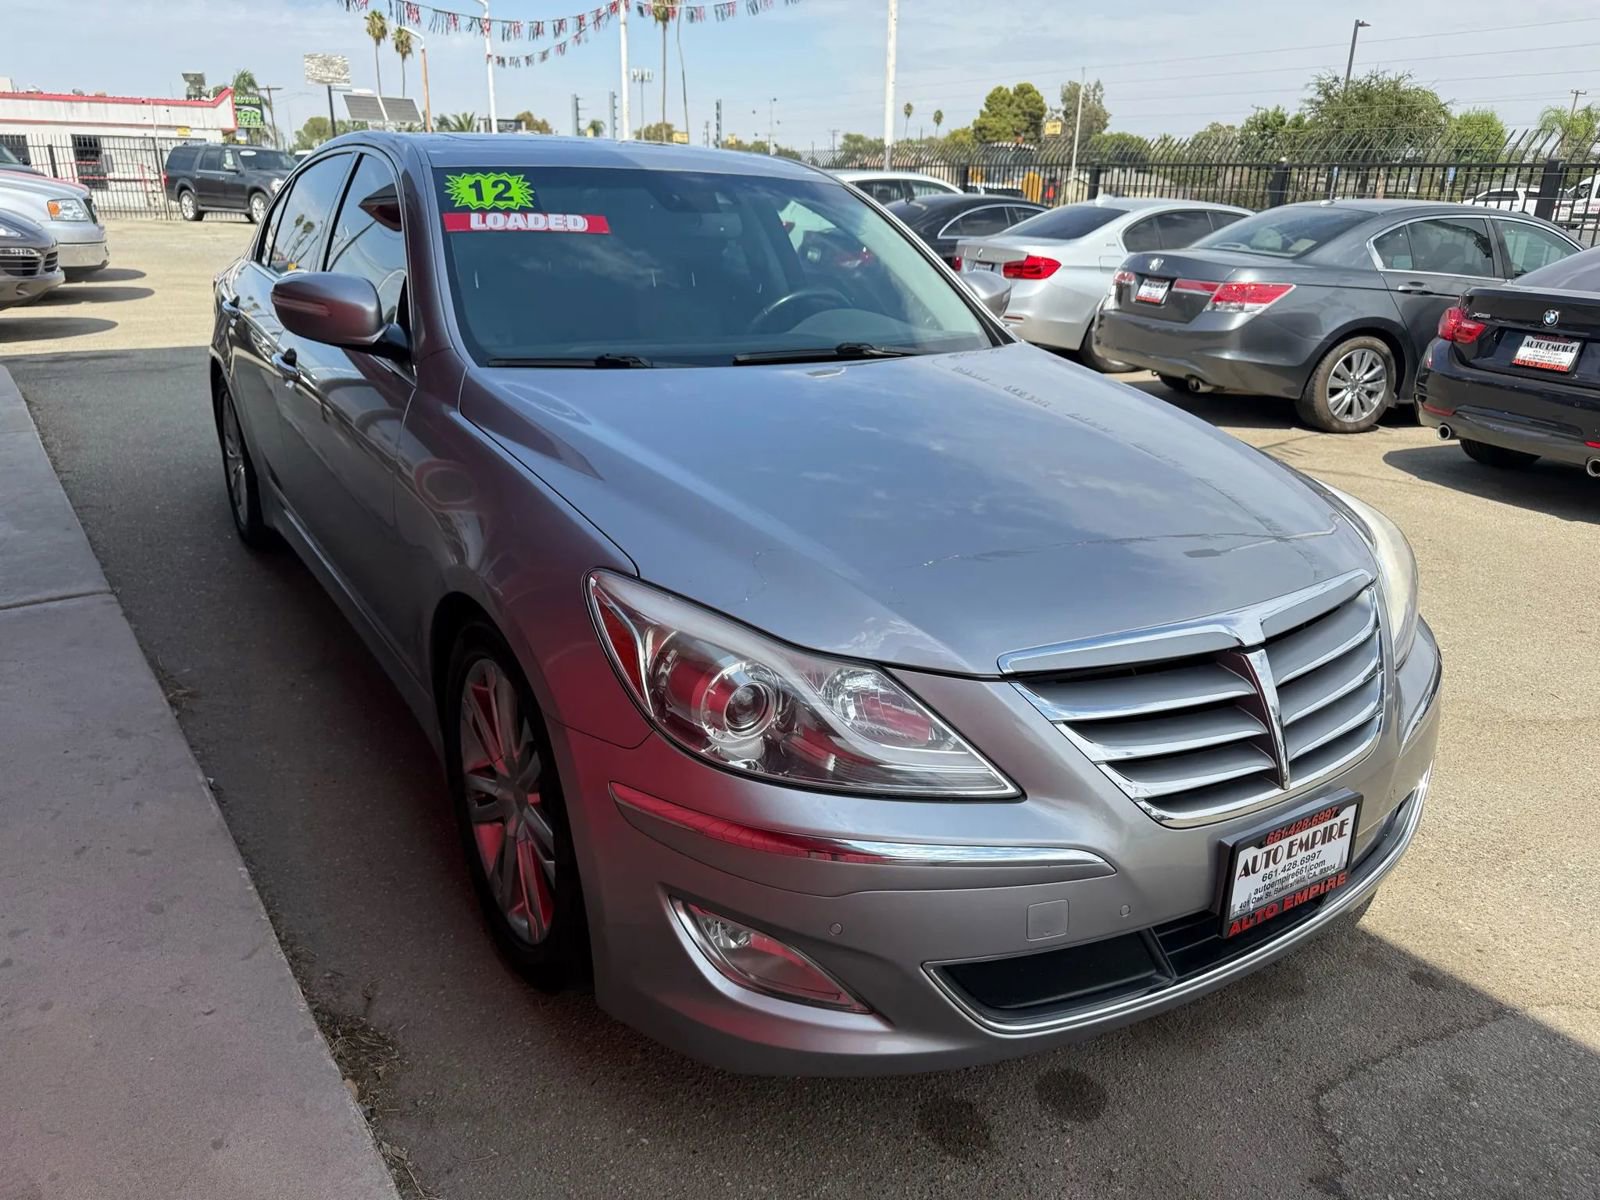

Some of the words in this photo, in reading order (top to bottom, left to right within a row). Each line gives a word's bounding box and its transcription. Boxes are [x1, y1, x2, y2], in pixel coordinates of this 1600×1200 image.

[468, 179, 515, 202] 12
[470, 212, 588, 231] LOADED
[1237, 845, 1285, 880] AUTO
[1286, 818, 1349, 860] EMPIRE
[1253, 859, 1326, 895] autoempire661.com
[1261, 850, 1322, 882] 661.428.6997
[1227, 902, 1279, 937] AUTO
[1283, 872, 1348, 912] EMPIRE
[1251, 895, 1264, 904] Oak
